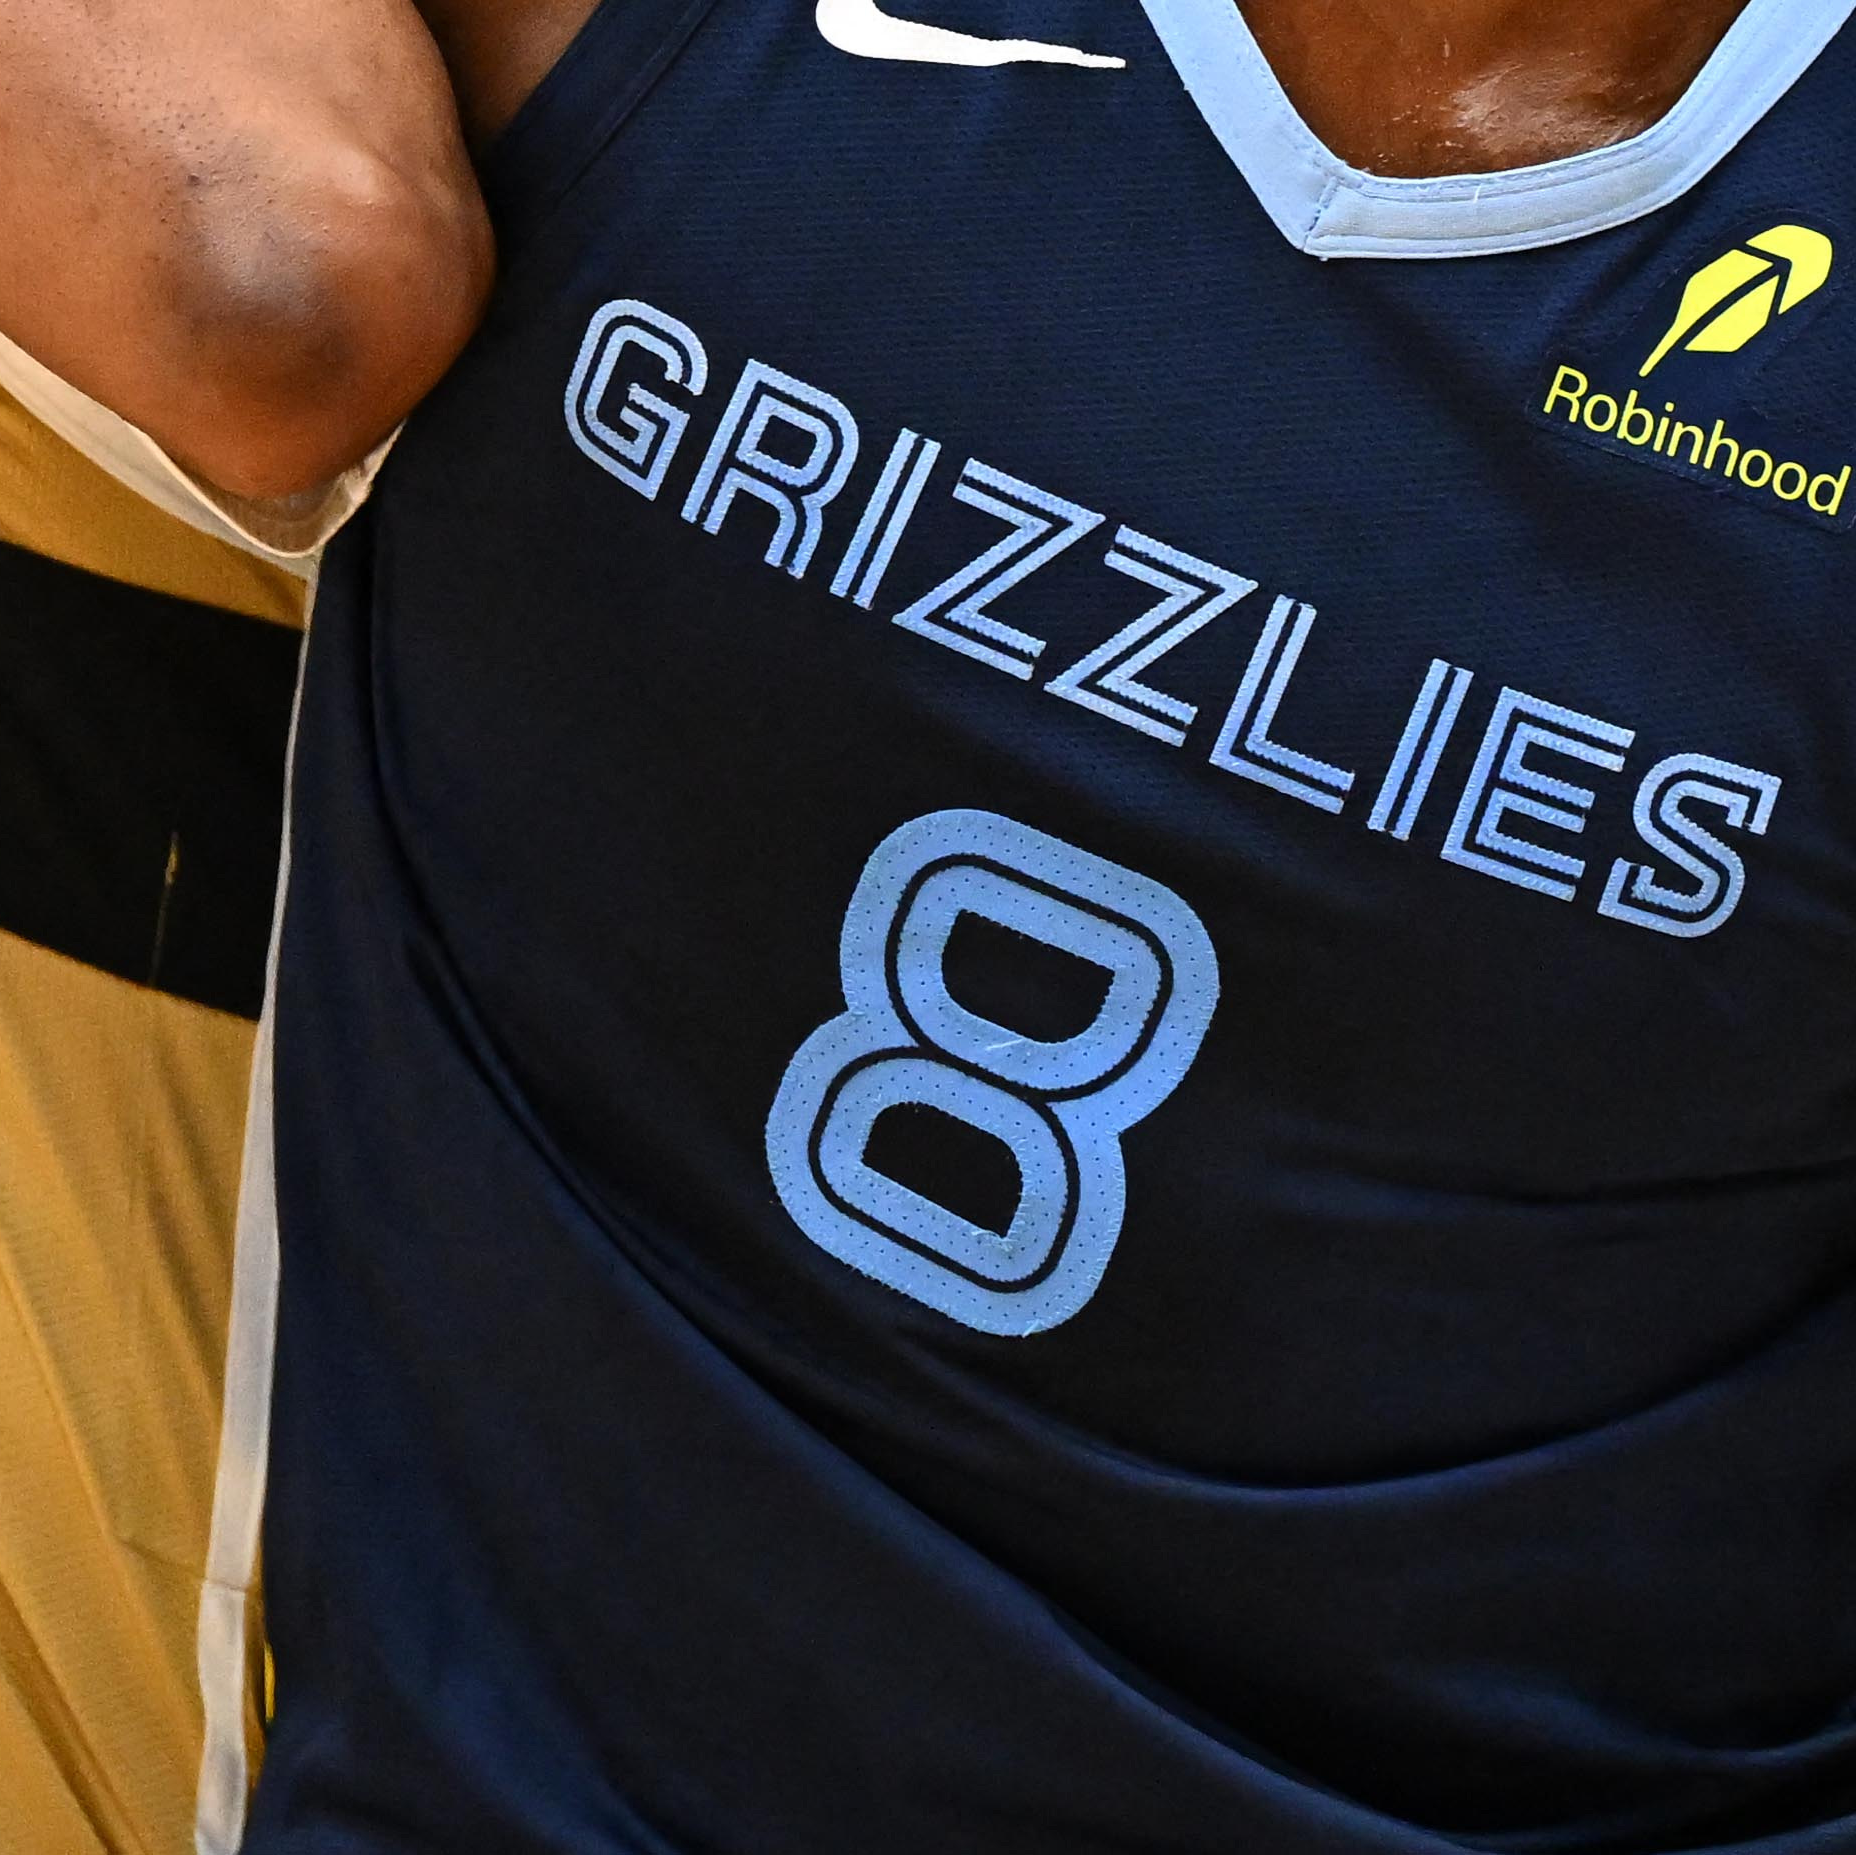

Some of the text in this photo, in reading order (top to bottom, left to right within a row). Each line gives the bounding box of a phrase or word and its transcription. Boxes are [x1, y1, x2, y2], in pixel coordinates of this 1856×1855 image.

[564, 298, 1783, 939] GRIZZLIES
[1543, 364, 1852, 516] Robinhood
[765, 808, 1221, 1338] 8
